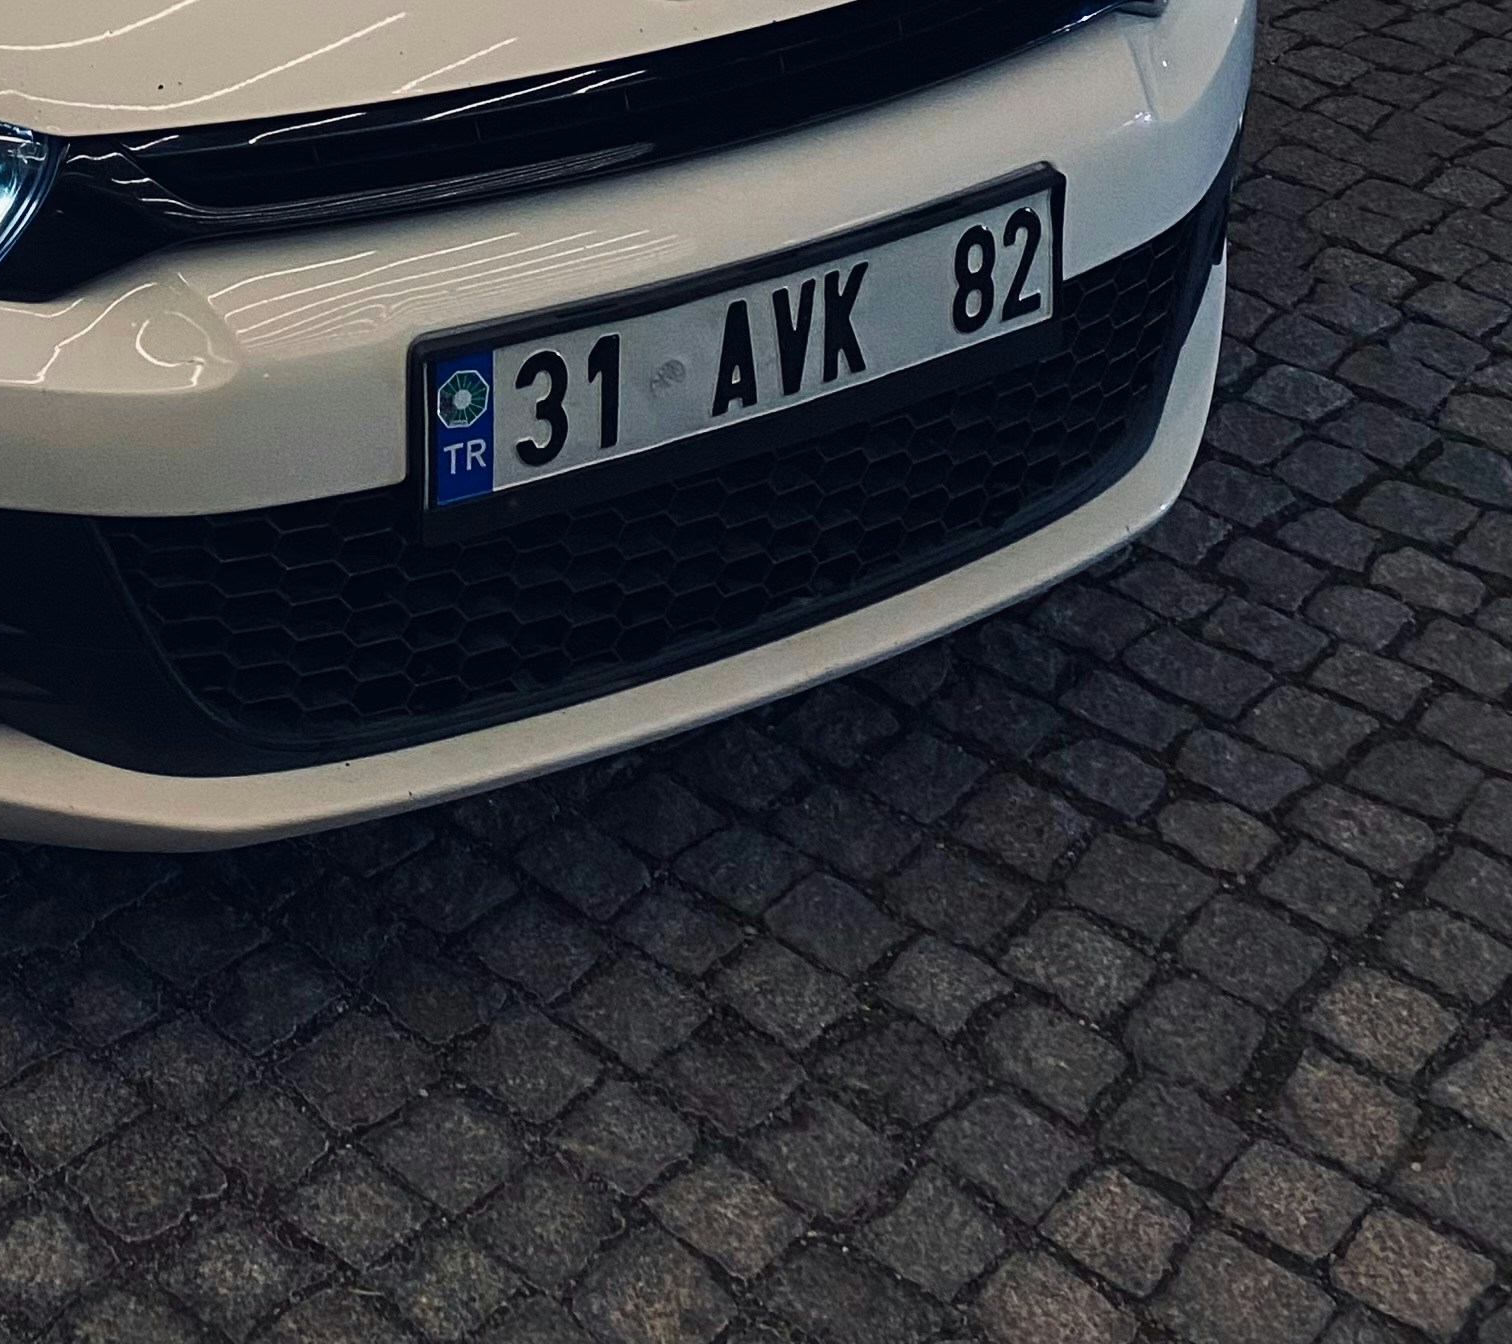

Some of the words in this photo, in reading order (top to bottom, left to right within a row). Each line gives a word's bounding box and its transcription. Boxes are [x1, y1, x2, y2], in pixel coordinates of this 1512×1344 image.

[514, 334, 621, 466] 31
[711, 261, 869, 417] AVK
[950, 206, 1043, 334] 82
[443, 439, 486, 474] TR
